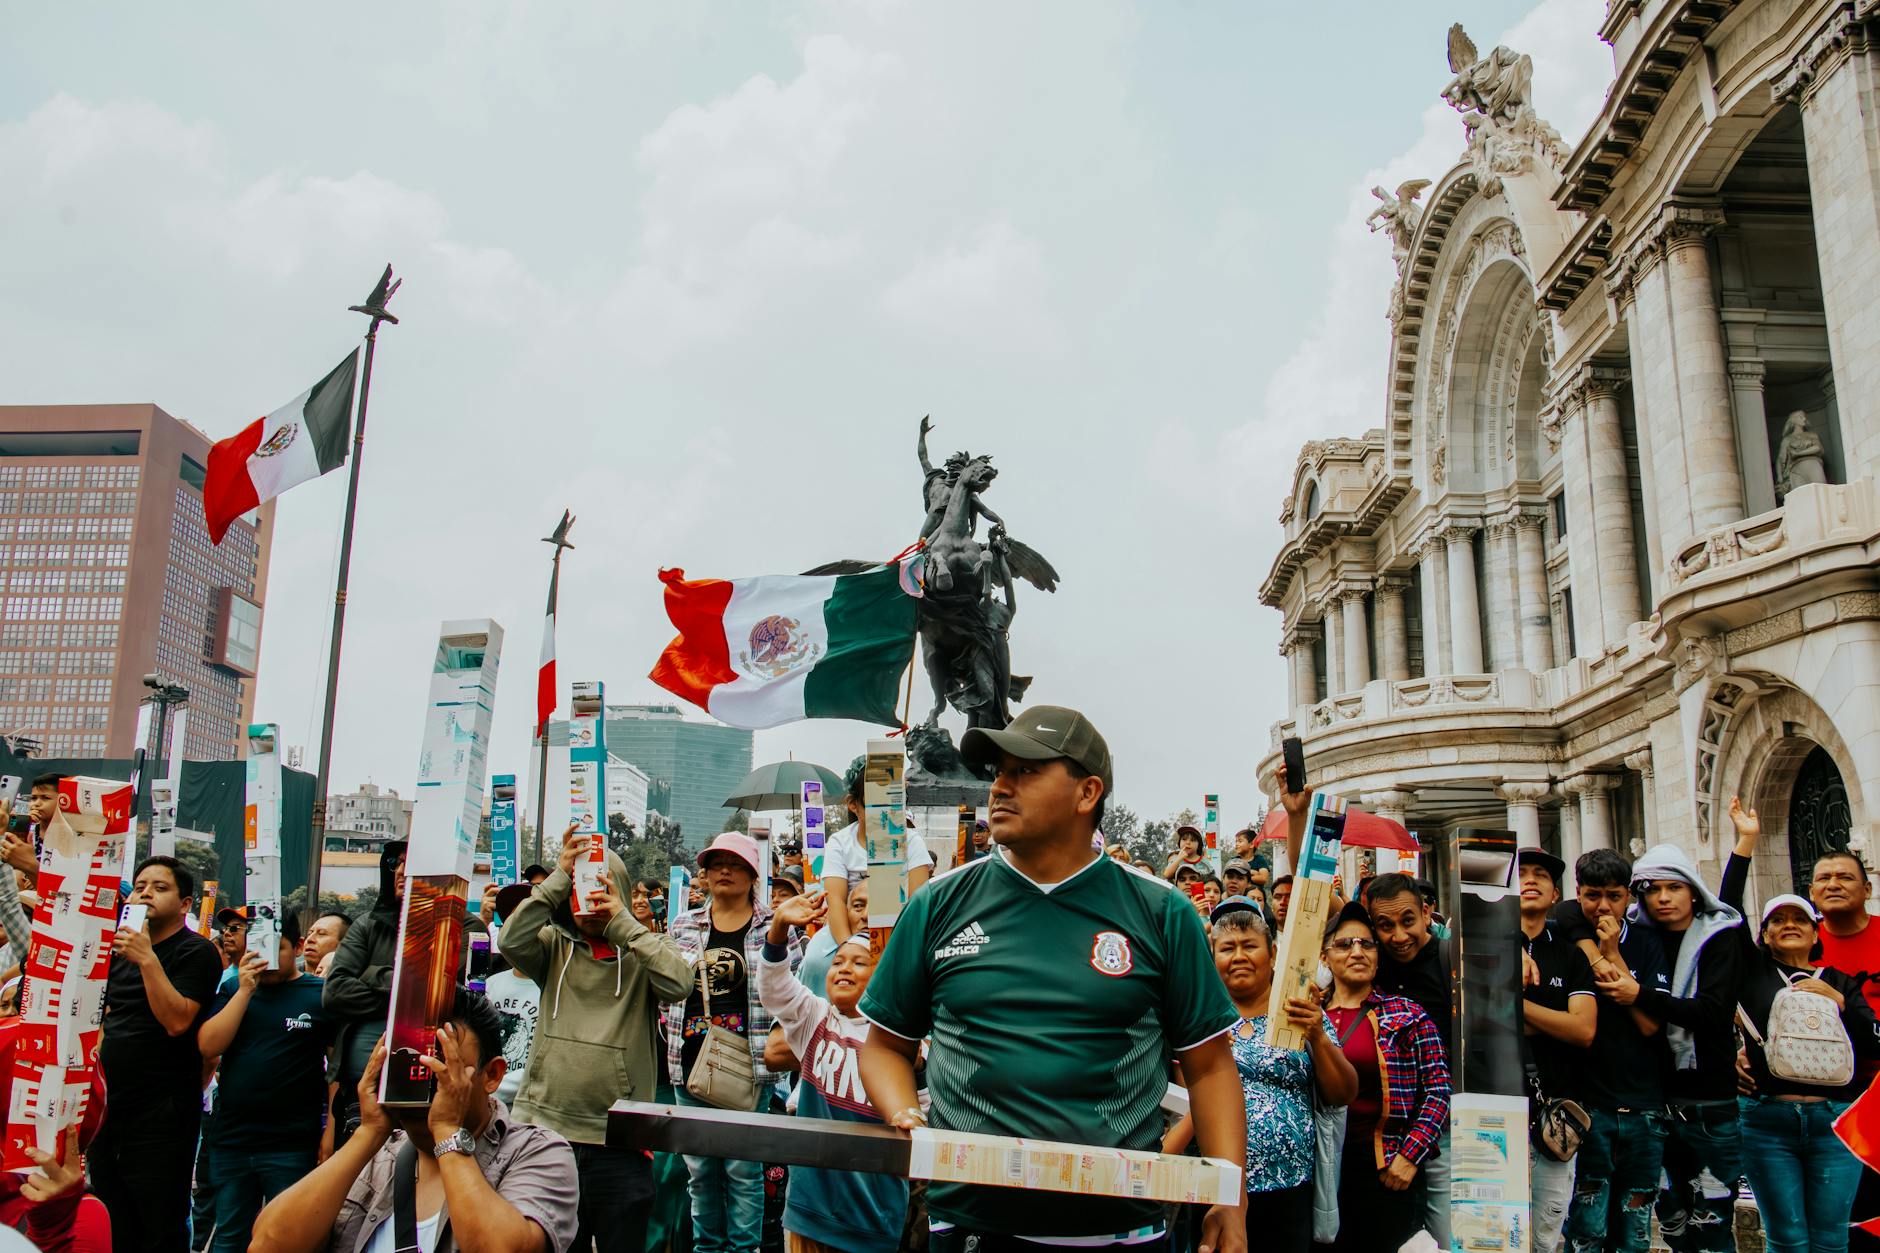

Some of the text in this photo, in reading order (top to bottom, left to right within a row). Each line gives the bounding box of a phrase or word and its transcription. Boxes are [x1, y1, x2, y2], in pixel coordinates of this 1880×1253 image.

[1520, 320, 1533, 351] DE
[951, 935, 990, 946] adidas
[20, 977, 31, 1021] POPCORN
